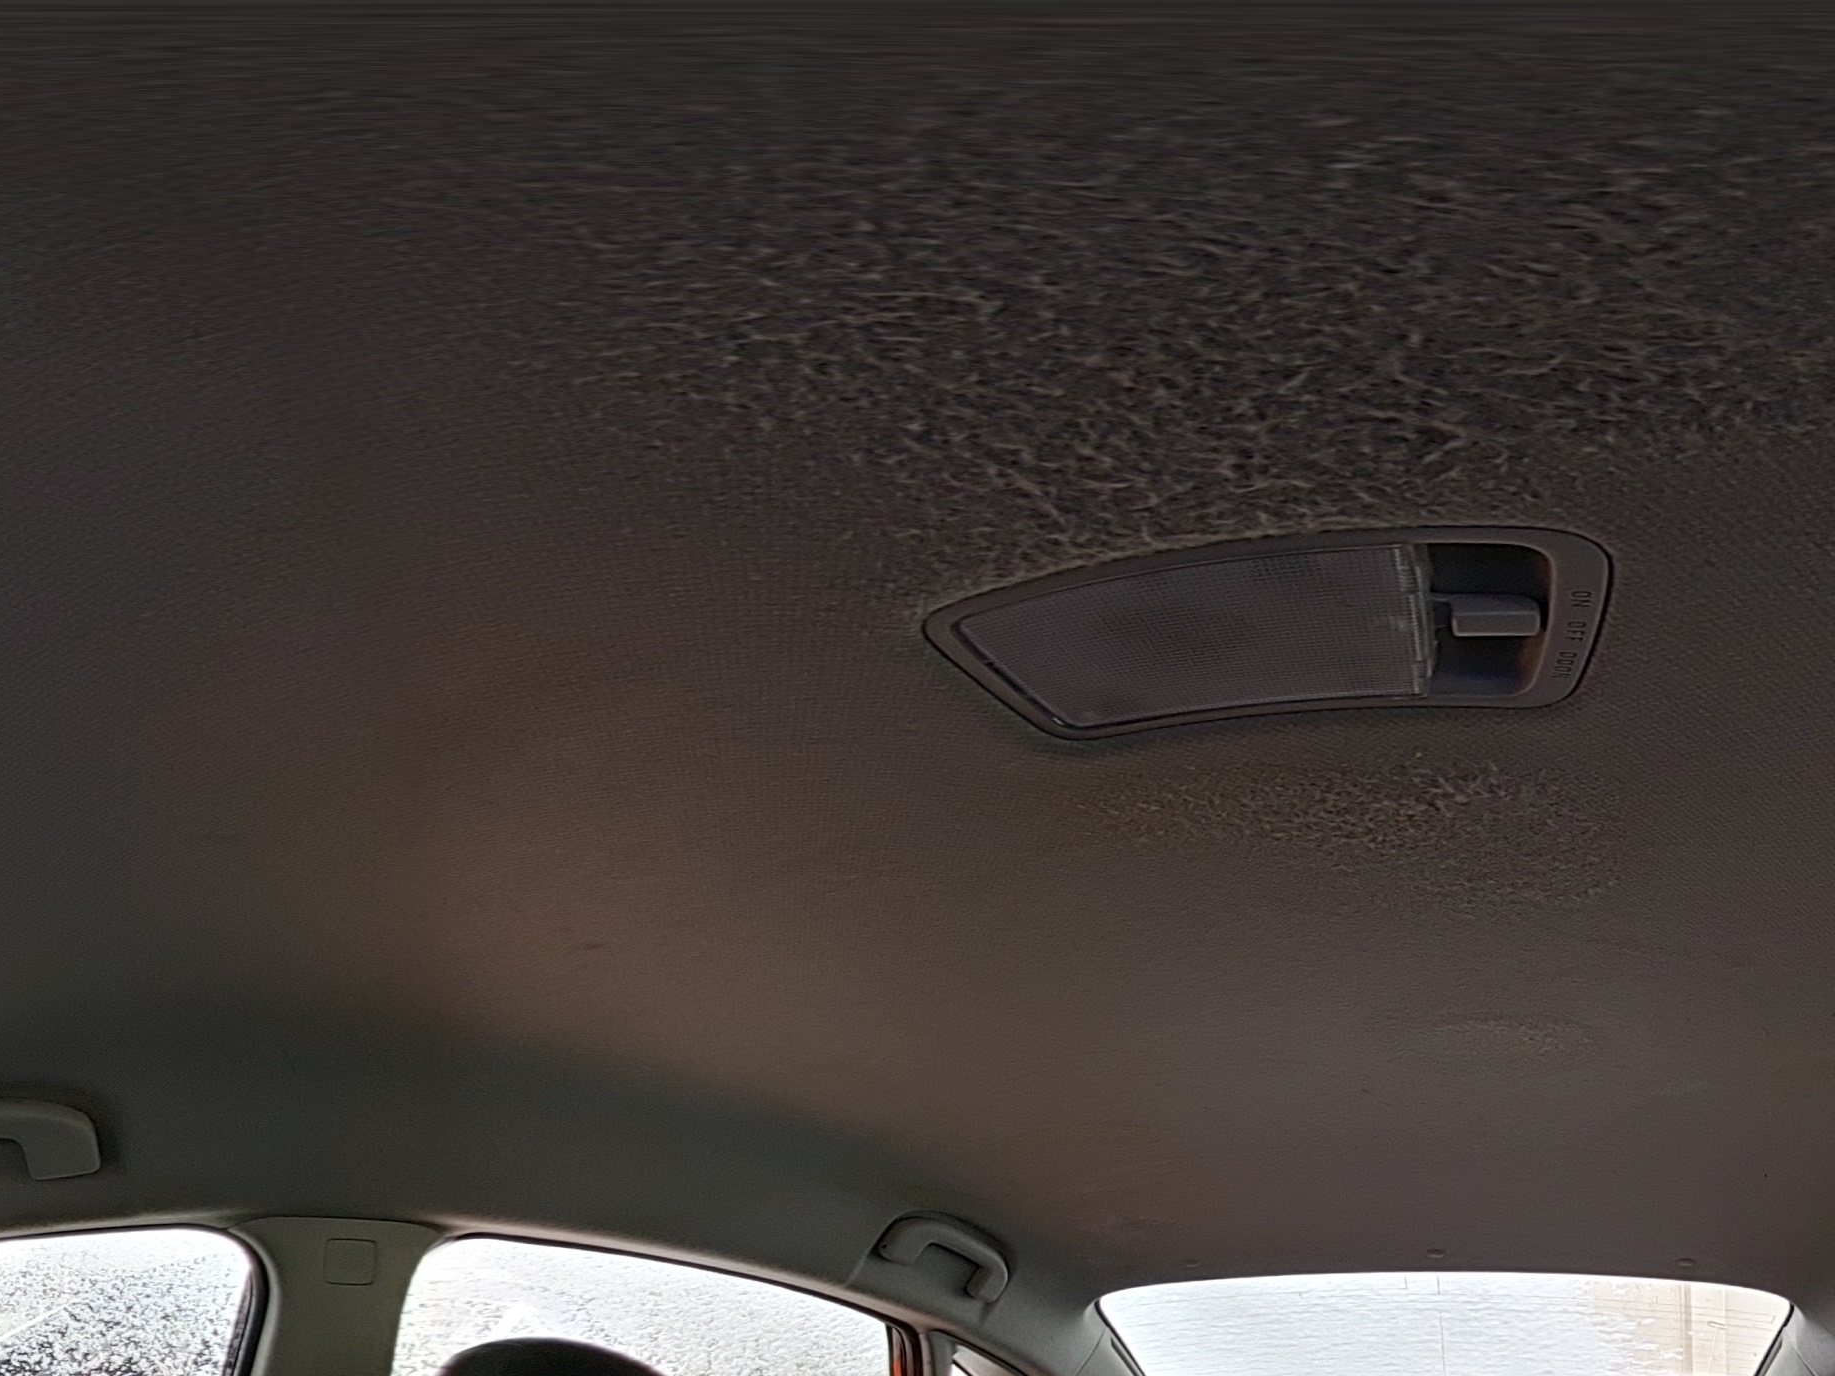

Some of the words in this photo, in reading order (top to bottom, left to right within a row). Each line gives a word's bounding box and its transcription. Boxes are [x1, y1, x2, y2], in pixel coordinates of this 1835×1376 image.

[1570, 589, 1594, 608] ON
[1564, 621, 1587, 643] OFF
[1550, 651, 1578, 679] DOOR
